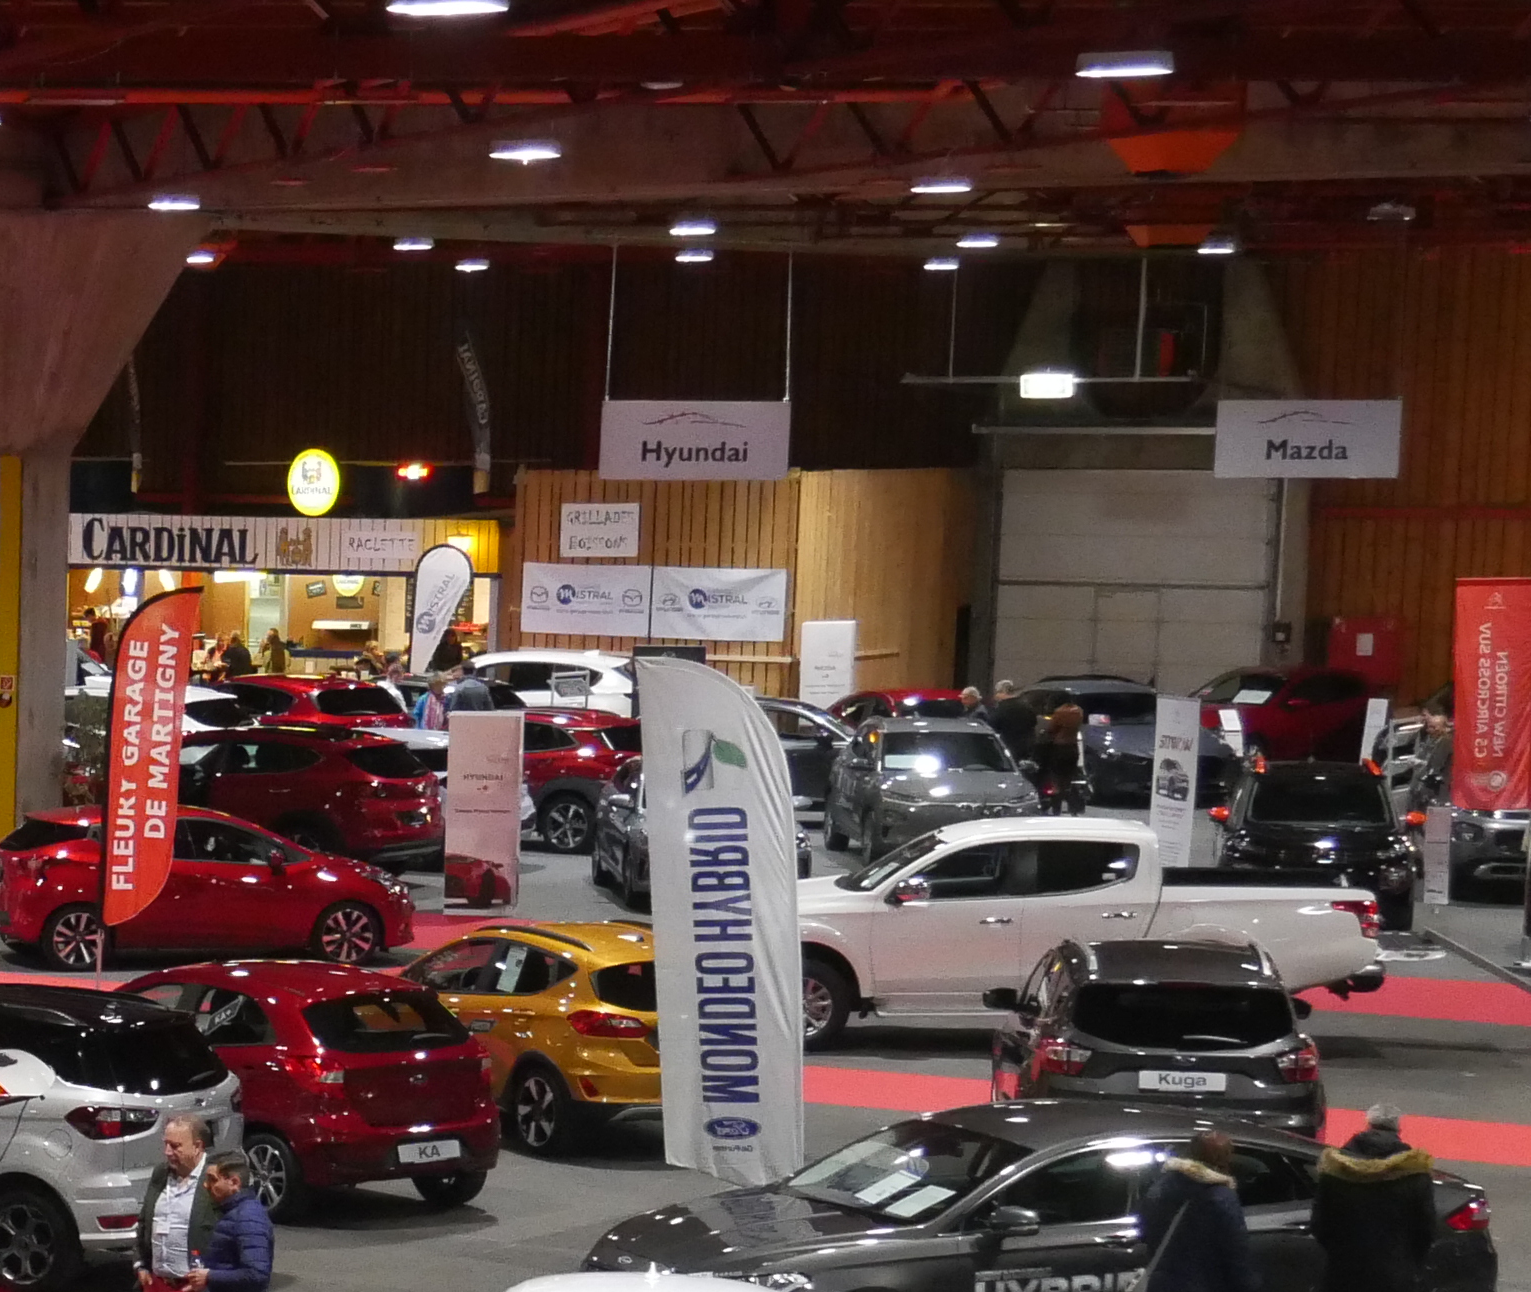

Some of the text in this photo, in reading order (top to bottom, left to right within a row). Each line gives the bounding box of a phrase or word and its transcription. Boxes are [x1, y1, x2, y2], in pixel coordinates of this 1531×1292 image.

[641, 440, 749, 469] Hyundai
[1265, 438, 1349, 461] Mazda
[347, 535, 416, 553] RACLETTE
[122, 639, 149, 767] GARAGE
[143, 622, 181, 840] DE MARTIGNY
[1158, 1073, 1208, 1089] Kuga
[418, 1144, 441, 1159] KA
